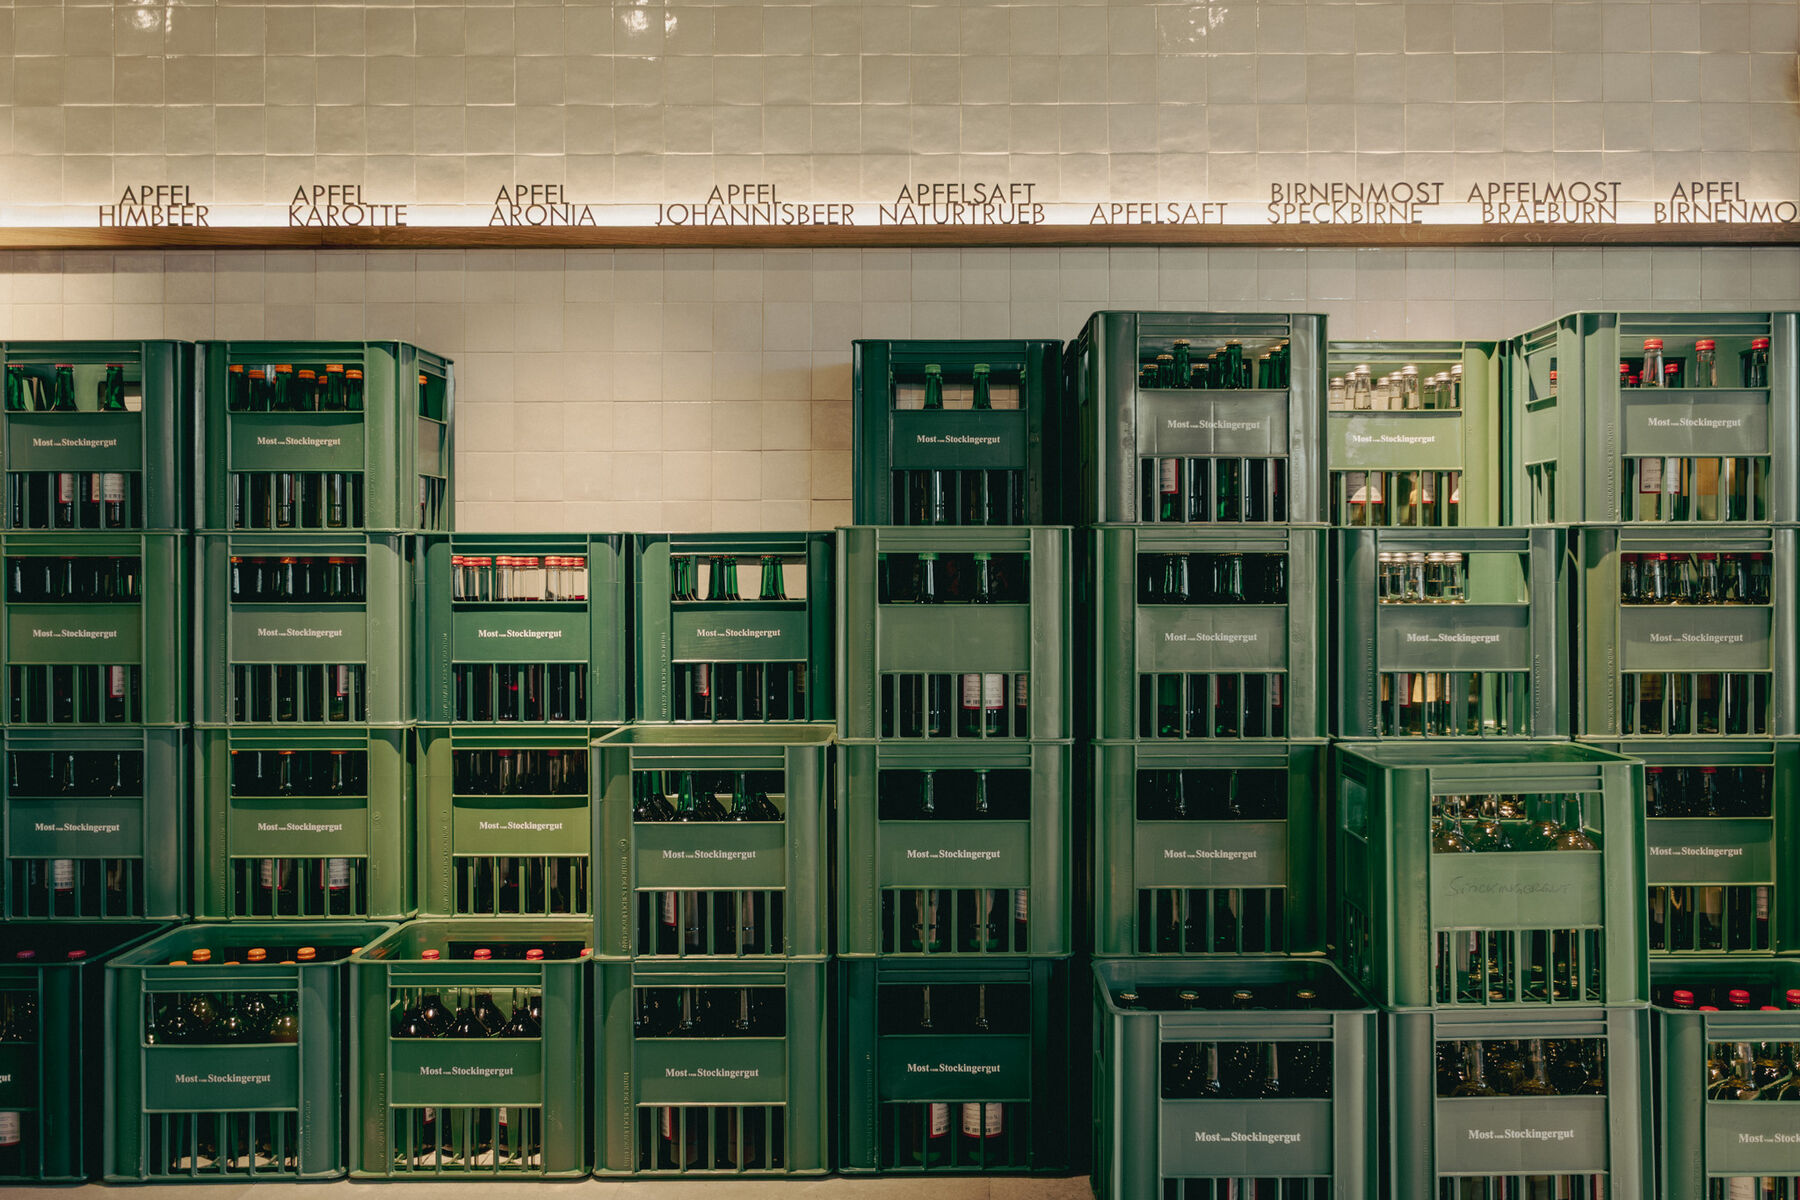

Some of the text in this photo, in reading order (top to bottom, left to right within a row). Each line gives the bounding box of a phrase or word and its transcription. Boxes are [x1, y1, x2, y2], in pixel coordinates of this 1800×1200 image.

[121, 185, 196, 206] APFEL
[293, 185, 367, 206] APFEL
[495, 184, 570, 205] APFEL
[708, 184, 782, 205] APFEL
[897, 183, 1036, 205] APFELSAFT
[1271, 182, 1444, 205] BIRNENMOST
[1467, 182, 1621, 203] APFELMOST
[1671, 182, 1746, 203] APFEL
[99, 205, 209, 227] HIMBEER
[289, 205, 408, 227] KAROTTE
[489, 204, 597, 227] ARONIA
[655, 204, 854, 227] JOHANNISBEER
[879, 203, 1045, 226] NATURTRUEB
[1090, 203, 1228, 226] APFELSAFT
[1267, 202, 1423, 225] SPECKBIRNE
[1483, 201, 1617, 224] BRAEBURN
[1647, 417, 1671, 426] Most
[1680, 417, 1741, 429] Stockingergut
[33, 437, 54, 446] Most
[61, 437, 117, 448] Stockingergut
[257, 436, 278, 445] Most
[285, 436, 341, 447] Stockingergut
[916, 434, 937, 443] Most
[944, 434, 1001, 445] Stockingergut
[32, 629, 54, 638] Most
[61, 629, 117, 640] Stockingergut
[257, 627, 279, 636] Most
[286, 627, 343, 639] Stockingergut
[478, 629, 499, 638] Most
[506, 629, 562, 640] Stockingergut
[697, 628, 717, 637] Most
[725, 628, 781, 639] Stockingergut
[1164, 632, 1187, 642] Most
[1196, 632, 1258, 644] Stockingergut
[1406, 633, 1430, 642] Most
[1438, 633, 1500, 644] Stockingergut
[1649, 633, 1673, 642] Most
[1681, 633, 1743, 644] Stockingergut
[35, 822, 56, 831] Most
[63, 822, 120, 833] Stockingergut
[257, 822, 279, 831] Most
[286, 822, 343, 833] Stockingergut
[479, 821, 500, 830] Most
[507, 821, 563, 832] Stockingergut
[662, 849, 686, 858] Most
[694, 849, 757, 861] Stockingergut
[906, 849, 930, 859] Most
[938, 849, 1001, 861] Stockingergut
[1163, 849, 1187, 859] Most
[1195, 849, 1257, 861] Stockingergut
[1649, 847, 1672, 856] Most
[1681, 847, 1743, 858] Stockingergut
[420, 1066, 443, 1075] Most
[451, 1066, 514, 1077] Stockingergut
[665, 1068, 689, 1078] Most
[697, 1068, 760, 1080] Stockingergut
[907, 1063, 930, 1073] Most
[938, 1063, 1001, 1075] Stockingergut
[175, 1073, 199, 1083] Most
[207, 1073, 271, 1085] Stockingergut
[1194, 1131, 1302, 1145] Most Stockingergut
[1468, 1128, 1575, 1142] Most Stockingergut
[1738, 1133, 1764, 1143] Most
